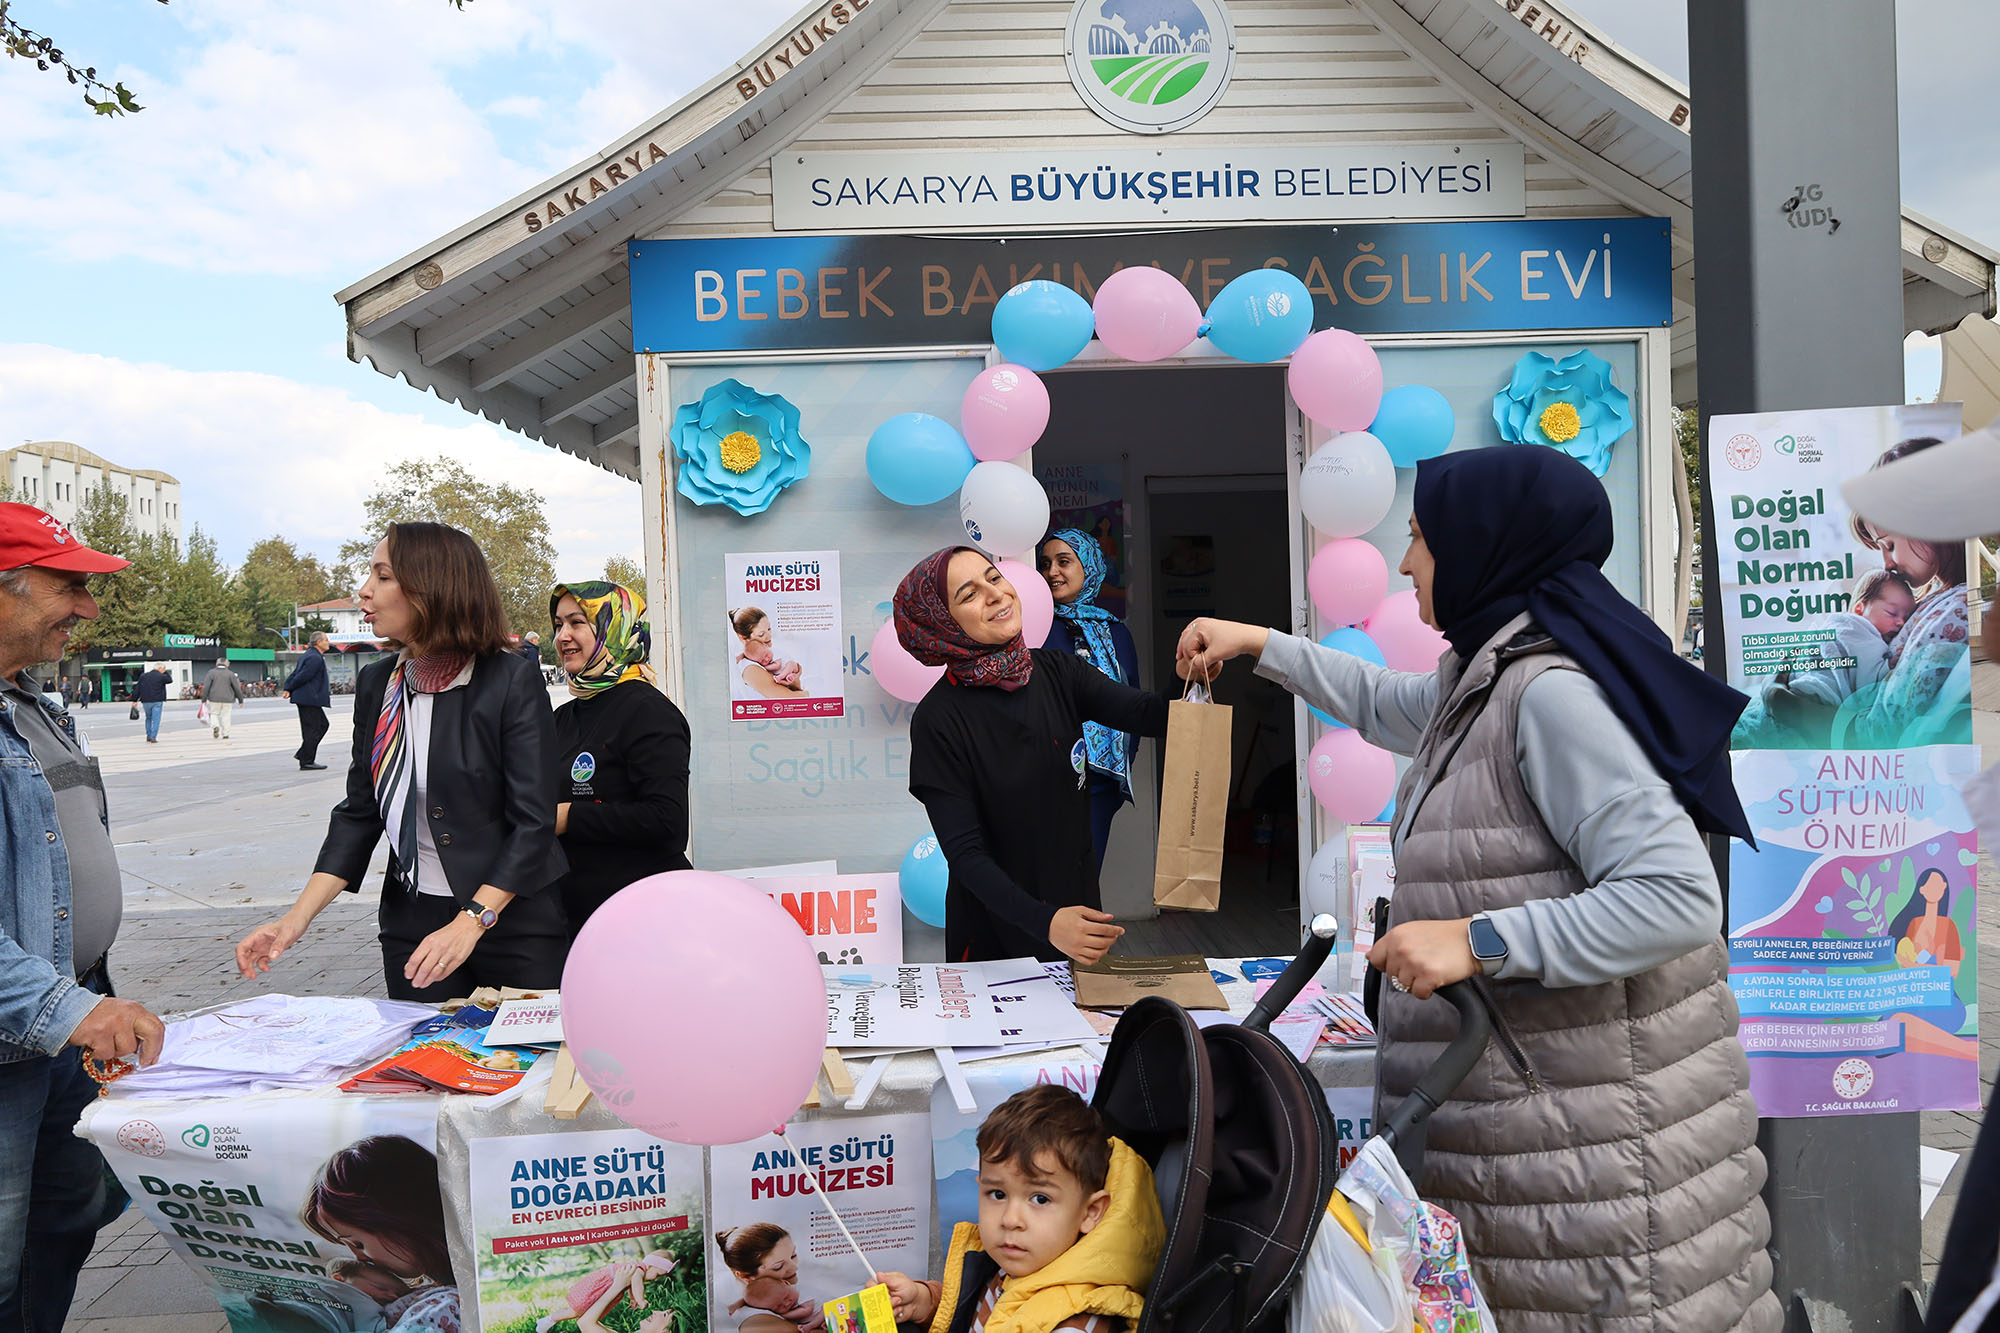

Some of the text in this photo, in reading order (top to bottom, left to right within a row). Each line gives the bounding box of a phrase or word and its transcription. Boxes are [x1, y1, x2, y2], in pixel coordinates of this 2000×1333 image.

[524, 142, 668, 233] SAKARYA
[810, 159, 1493, 207] SAKARYA BÜYÜKŞEHİR BELEDİYESİ
[695, 265, 895, 322] BEBEK
[1521, 232, 1611, 301] EVİ
[1798, 449, 1824, 457] NORMAL
[1730, 488, 1824, 523] Doğal
[1734, 525, 1811, 553] Olan
[746, 561, 820, 577] ANNE SÜTÜ
[746, 574, 821, 593] MUCİZESİ
[1737, 553, 1854, 586] Normal
[1740, 588, 1851, 623] Doğum
[1743, 631, 1835, 646] Tıbbi olarak zorunlu
[1744, 647, 1820, 660] olmadığı sürece
[1744, 657, 1857, 675] sezaryen doğal değildir.
[747, 740, 869, 798] Sağlık
[1817, 753, 1905, 782] ANNE
[1189, 770, 1200, 837] www.sakarya.bel.tr
[1777, 783, 1925, 815] SÜTÜNÜN
[1804, 817, 1907, 850] ÖNEMİ
[768, 888, 878, 936] NNE
[1733, 938, 1763, 949] SEVGİLİ
[1764, 940, 1810, 950] ANNELER,
[1812, 939, 1863, 950] BEBEĞİNİZE
[1864, 939, 1877, 949] İLK
[1882, 939, 1891, 947] AY
[1753, 950, 1873, 960] SADECE ANNE SÜTÜ VERİNİZ
[892, 966, 925, 1009] Bebeğinize
[1734, 980, 1951, 999] BESİNLERLE BİRLİKTE EN AZ 2 YAŞ VE ÖTESİNE
[1787, 976, 1824, 986] SONRA
[1827, 976, 1843, 987] İSE
[1845, 976, 1877, 986] UYGUN
[1878, 969, 1931, 984] TAMAMLAYICI
[505, 1009, 560, 1019] ANNE
[849, 990, 876, 1039] Vereceğiniz
[1770, 994, 1925, 1012] KADAR EMZİRMEYE DEVAM EDİNİZ
[1744, 1022, 1888, 1037] HER BEBEK İÇİN EN İYİ BESİN
[1746, 1036, 1885, 1048] KENDİ ANNESİNİN SÜTÜDÜR
[1805, 1098, 1898, 1112] T.C. SAĞLIK BAKANLIĞI
[213, 1126, 242, 1135] DOĞAL
[216, 1151, 249, 1160] DOĞUM
[510, 1144, 664, 1182] ANNE SÜTÜ
[751, 1133, 894, 1171] ANNE SÜTÜ
[138, 1174, 265, 1208] Doğal
[510, 1168, 666, 1209] DOĞADAKİ
[751, 1157, 894, 1200] MUCİZESİ
[157, 1200, 256, 1229] Olan
[512, 1195, 667, 1225] EN ÇEVRECİ BESİNDİR
[170, 1221, 322, 1259] Normal
[504, 1220, 676, 1249] Paket yok Atık yok Karbon ayak izi düşük
[185, 1242, 327, 1278] Doğum
[307, 1296, 352, 1312] değildir.
